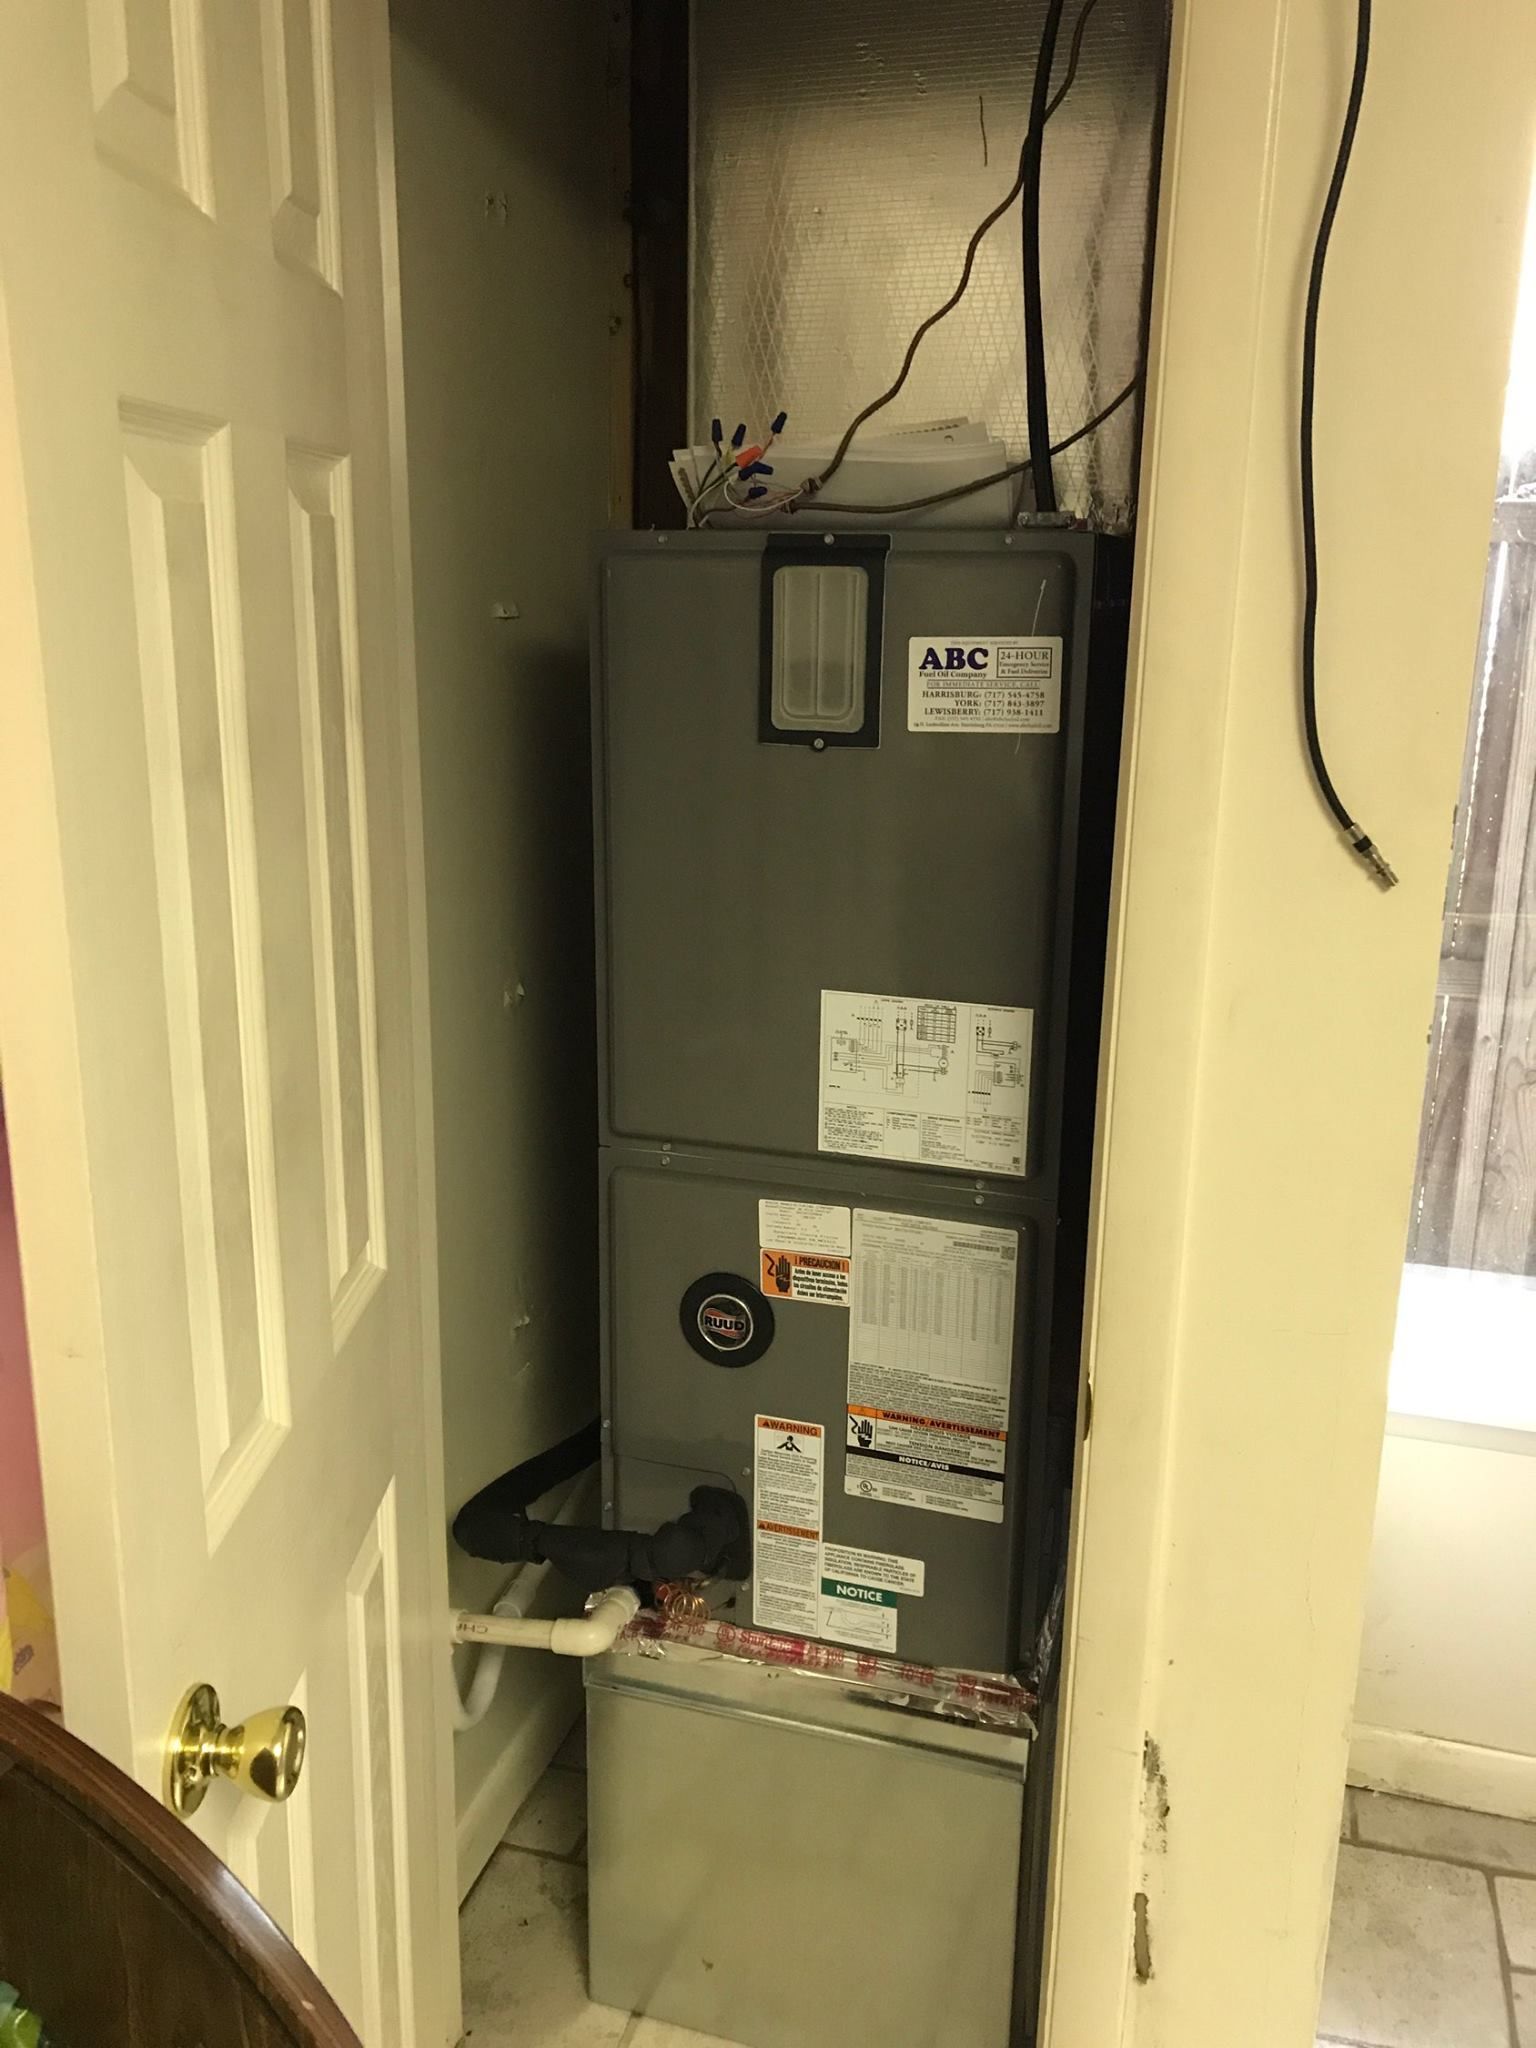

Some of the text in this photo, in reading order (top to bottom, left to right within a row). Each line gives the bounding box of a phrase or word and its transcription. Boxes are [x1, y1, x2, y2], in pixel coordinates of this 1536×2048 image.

[918, 647, 989, 670] ABC
[1000, 651, 1049, 660] 24-HOUR
[950, 671, 988, 679] Company
[921, 691, 982, 699] HARRISBURG:
[984, 691, 1005, 699] (717)
[984, 699, 1005, 708] (717)
[924, 708, 981, 716] LEWISBERRY:
[983, 708, 1004, 717] (717)
[704, 1315, 745, 1331] RUUD
[769, 1420, 818, 1436] WARNING
[882, 1411, 1001, 1439] WARNING/AVERTISSEMENT
[898, 1455, 950, 1471] NOTICE/AVIS
[766, 1522, 819, 1540] AVERTISSEMENT
[836, 1584, 883, 1603] NOTICE
[739, 1631, 792, 1652] Shurtape
